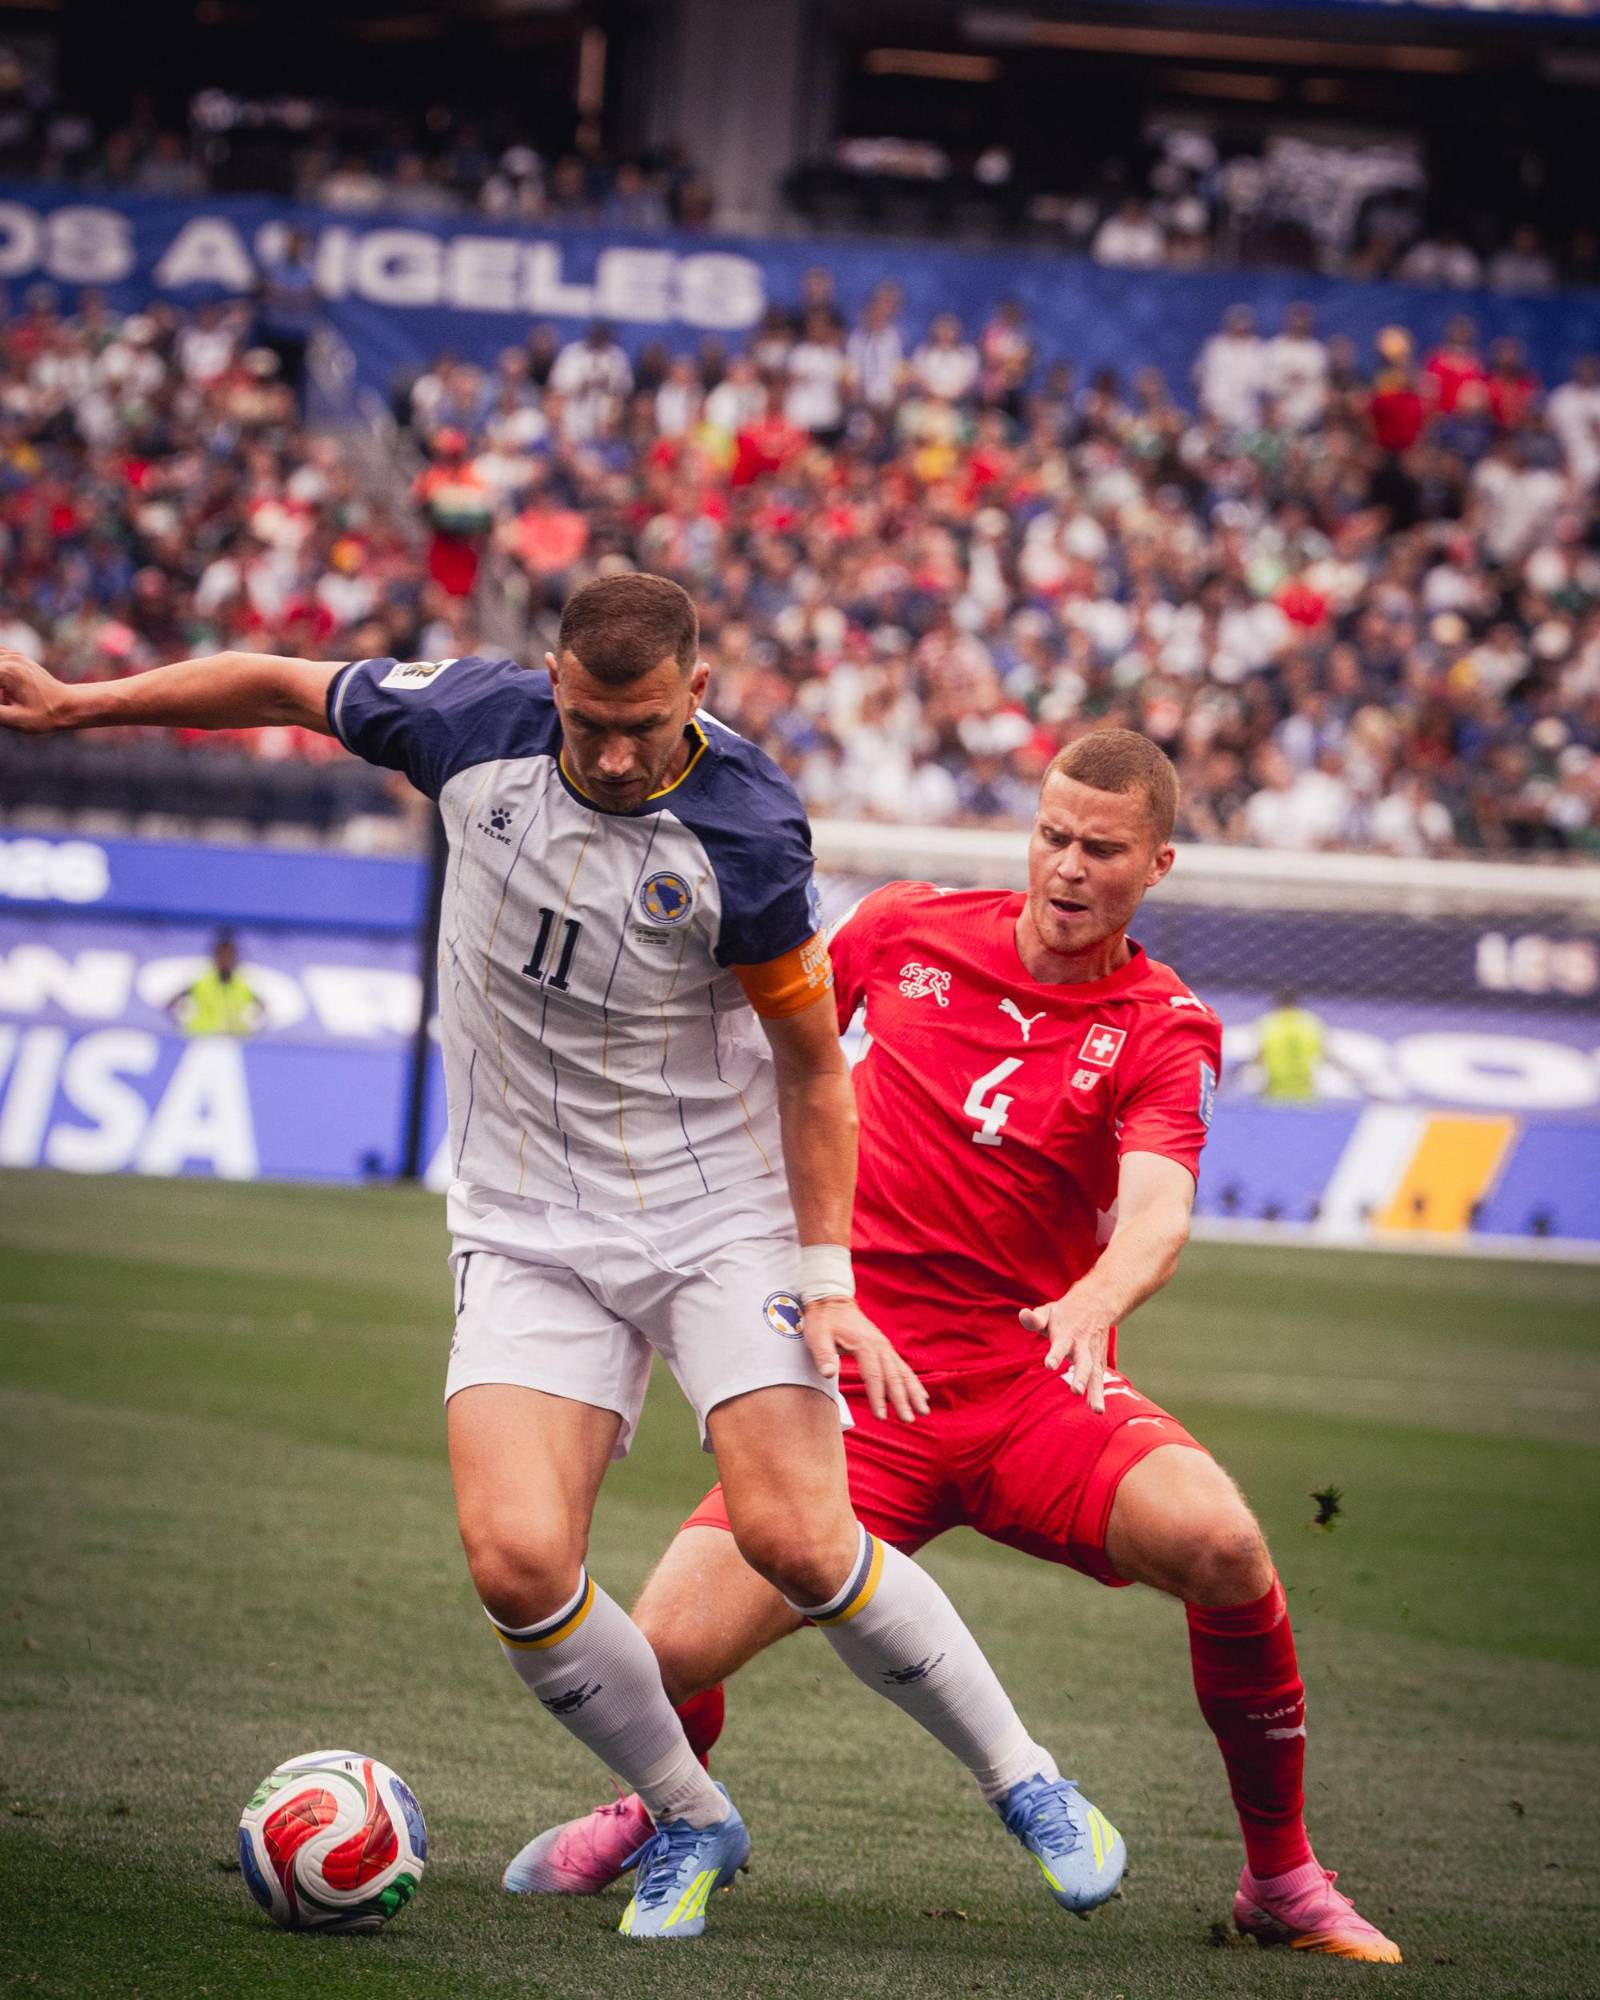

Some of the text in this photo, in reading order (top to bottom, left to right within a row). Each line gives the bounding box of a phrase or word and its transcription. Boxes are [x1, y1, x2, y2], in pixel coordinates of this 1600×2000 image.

[477, 821, 512, 846] KELME
[520, 906, 583, 993] 11
[962, 1056, 1025, 1147] 4
